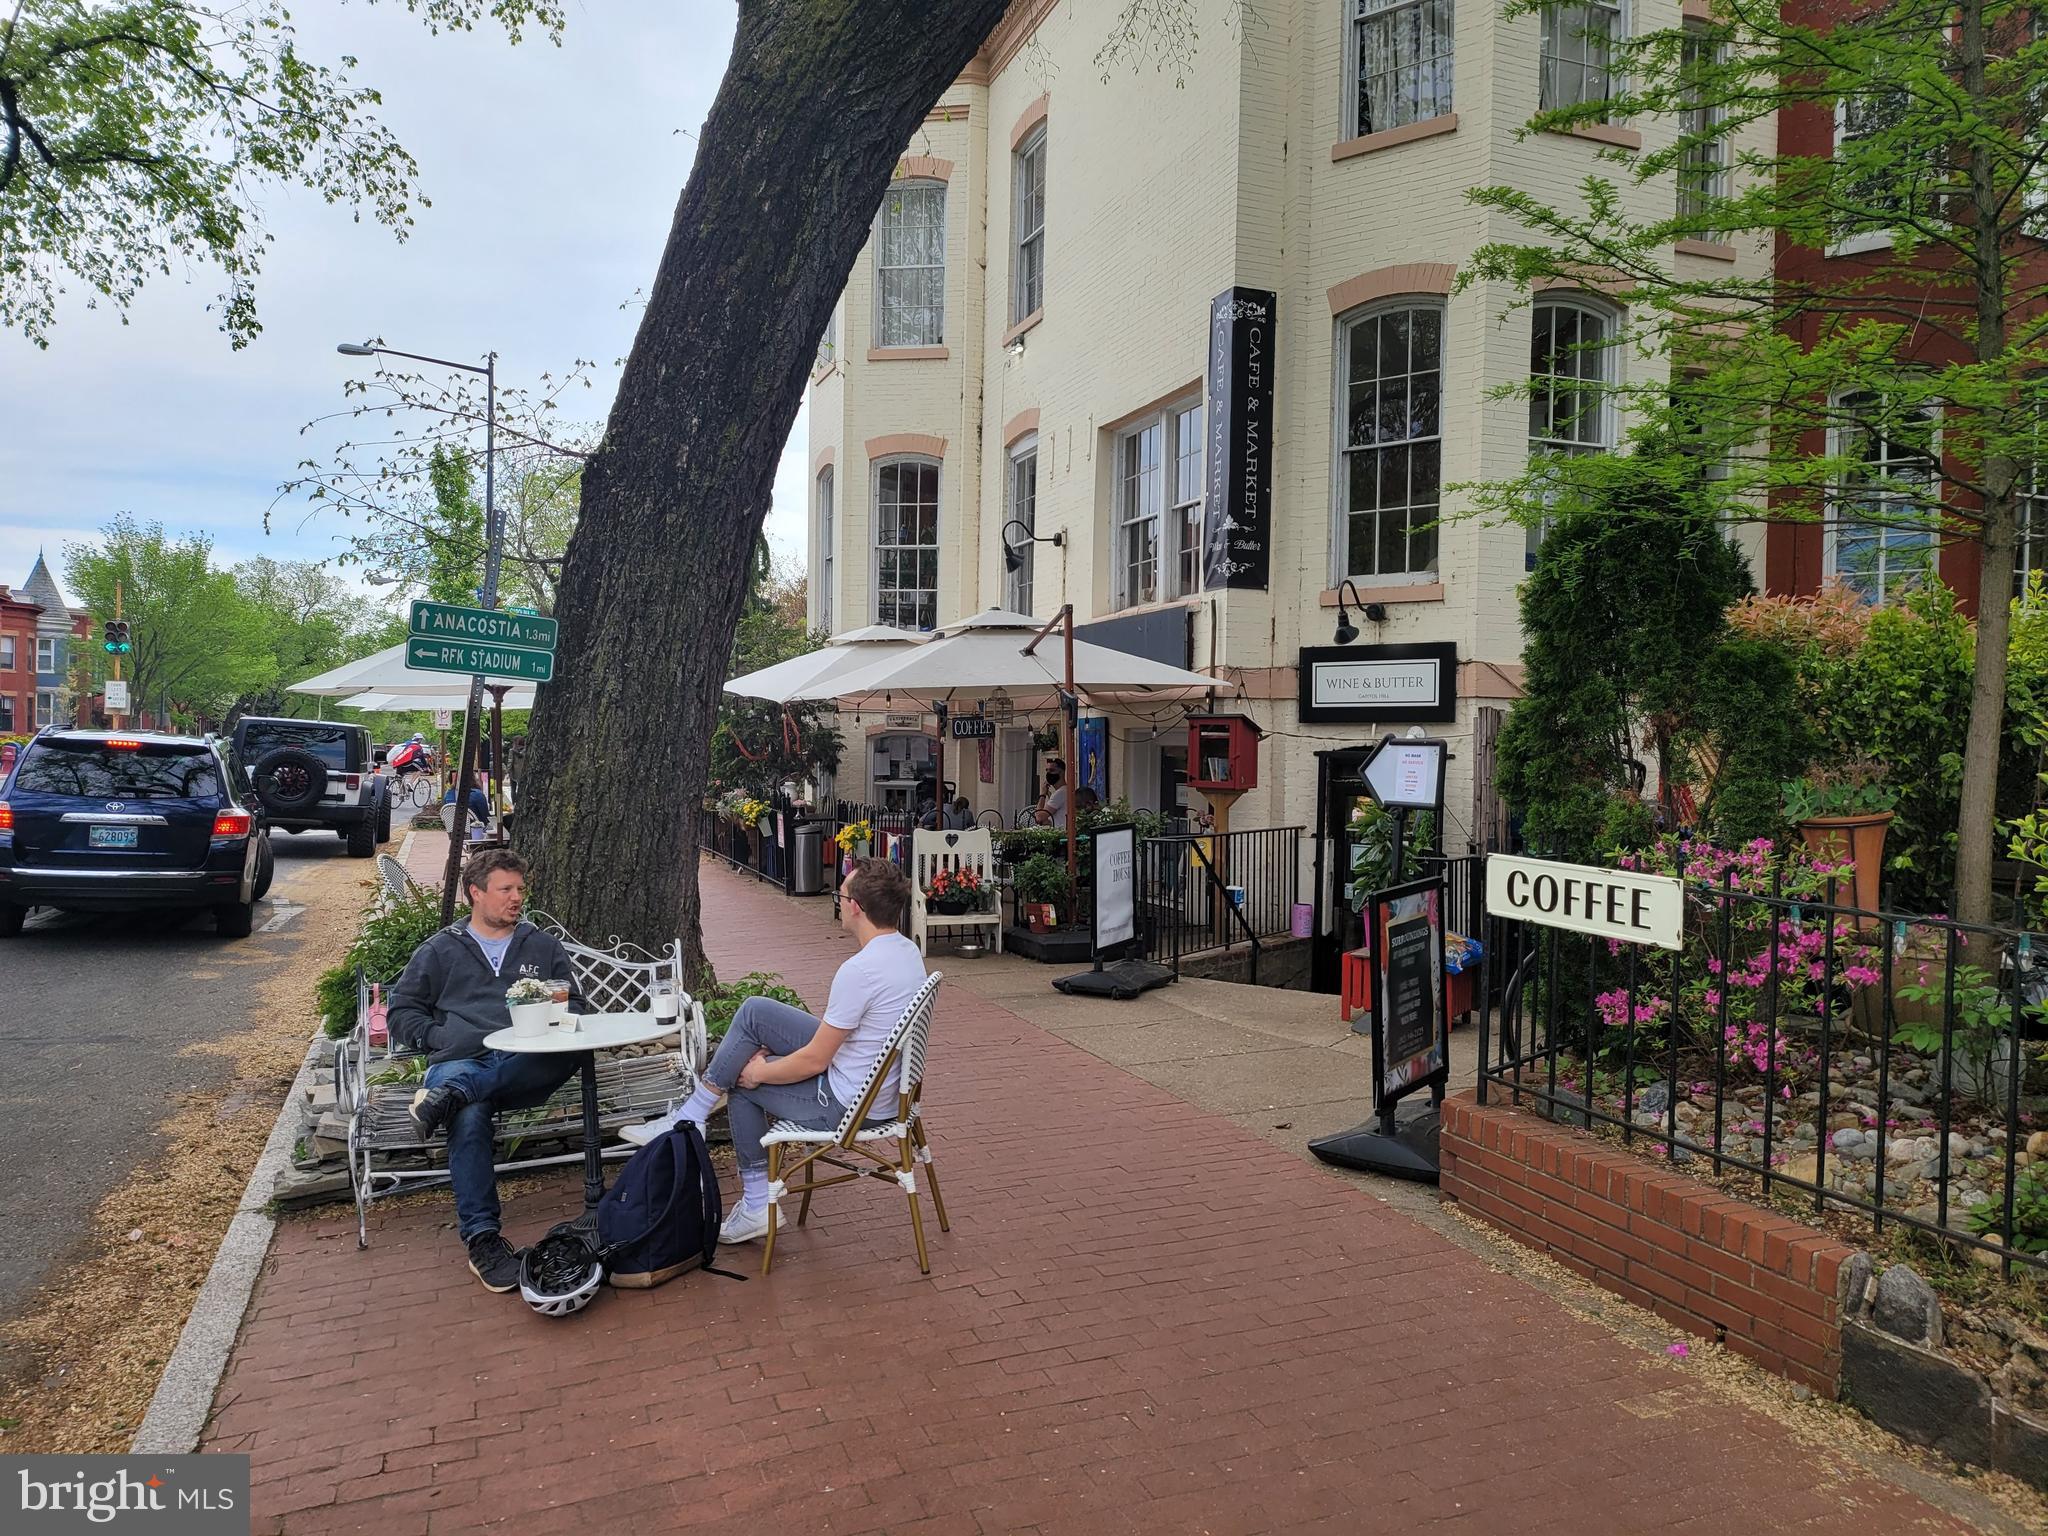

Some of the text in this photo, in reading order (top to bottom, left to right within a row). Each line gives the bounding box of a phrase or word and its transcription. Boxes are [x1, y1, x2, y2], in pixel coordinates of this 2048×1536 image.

[1245, 327, 1261, 519] CAFE & MARKET
[1212, 421, 1222, 520] MARKET
[433, 612, 521, 639] ANACOSTIA
[441, 647, 464, 665] RFK
[470, 650, 521, 671] STADIUM
[1326, 676, 1424, 689] WINE & BUTTER
[954, 720, 992, 735] COFFEE
[1109, 850, 1131, 867] COFFEE
[1507, 870, 1652, 930] COFFEE
